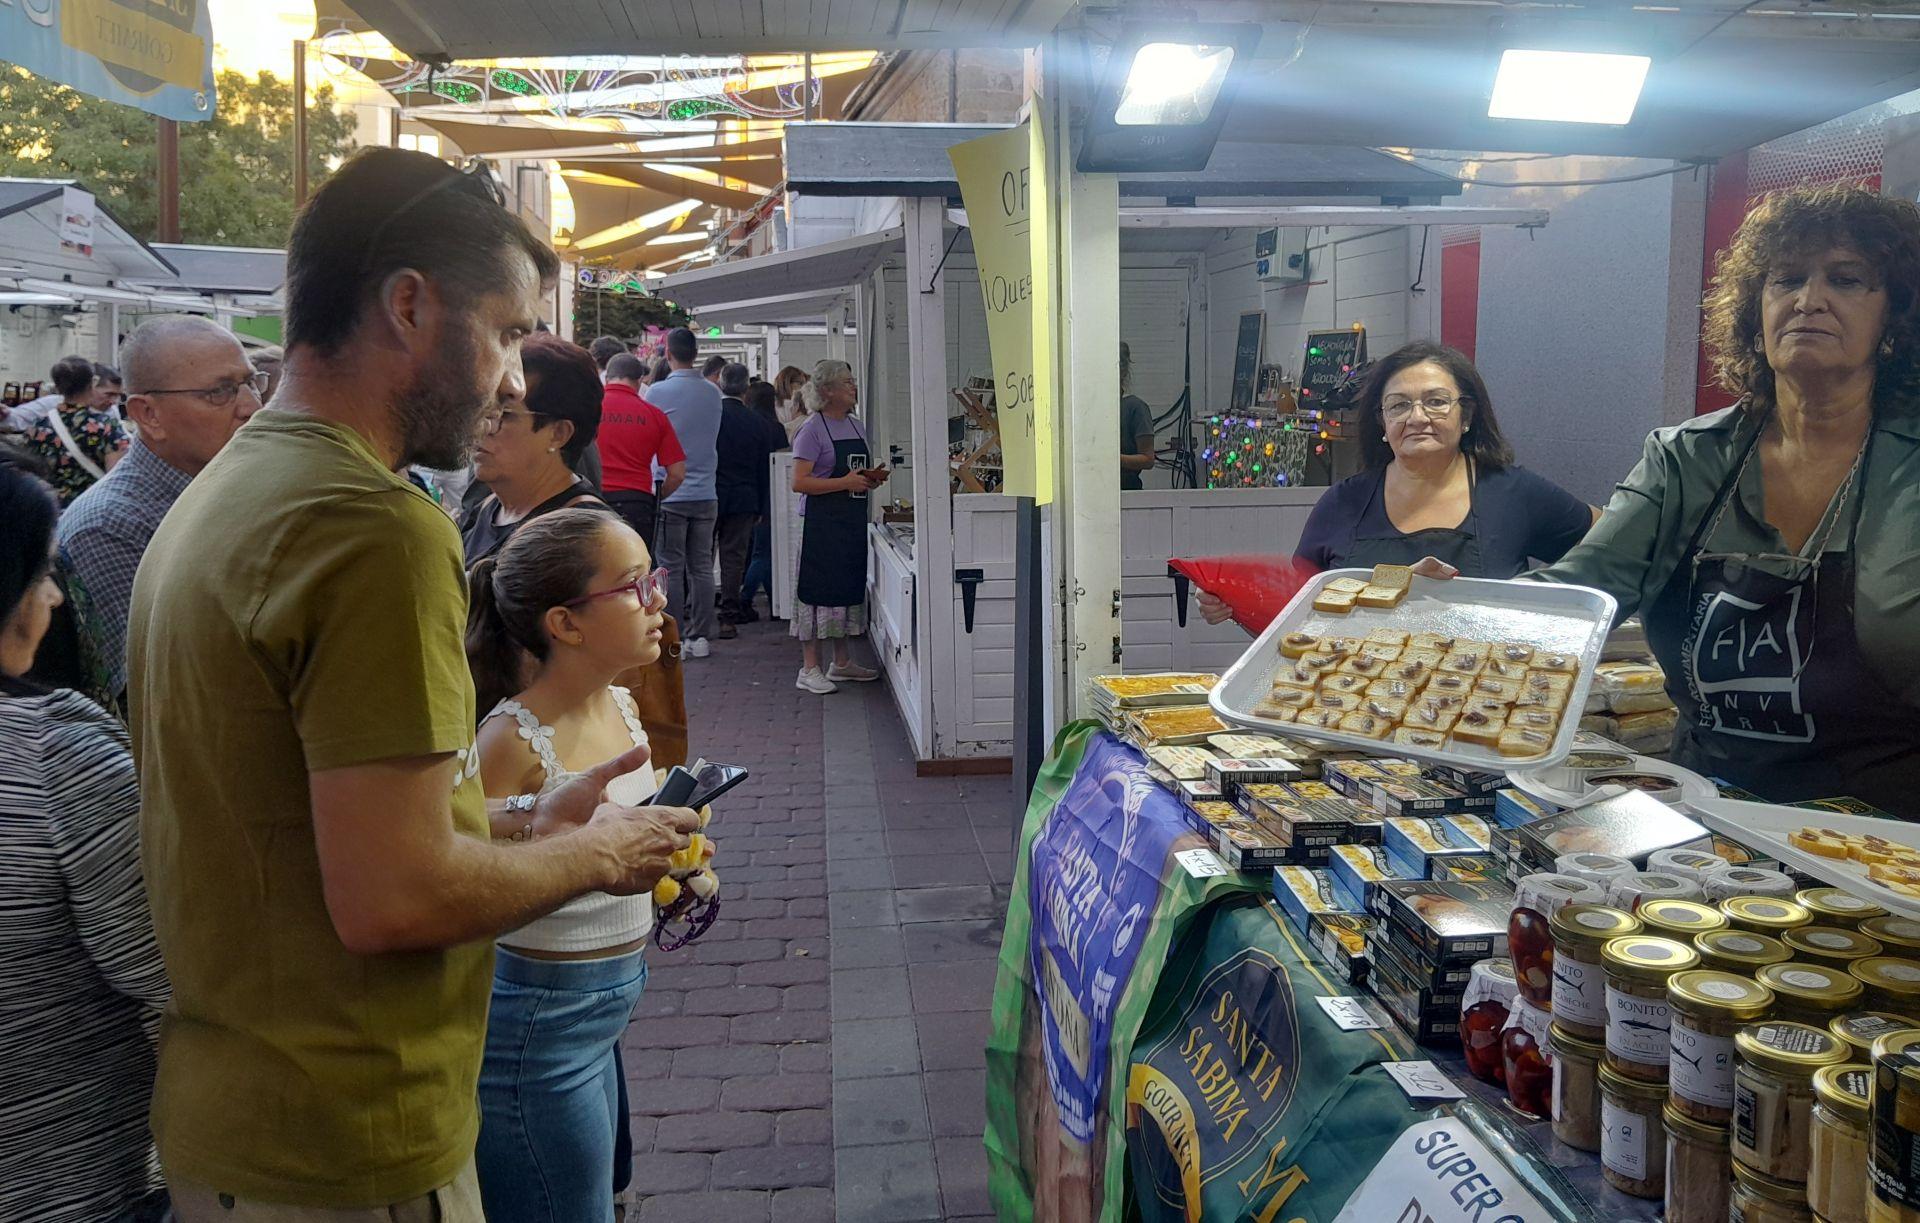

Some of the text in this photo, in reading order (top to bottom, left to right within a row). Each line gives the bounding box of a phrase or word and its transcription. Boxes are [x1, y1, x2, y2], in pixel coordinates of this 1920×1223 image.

[1711, 617, 1784, 673] FIA
[1211, 990, 1283, 1102] SANTA
[1617, 997, 1669, 1018] BONITO
[1179, 1026, 1250, 1144] SABINA
[1414, 1130, 1504, 1223] SUPER
